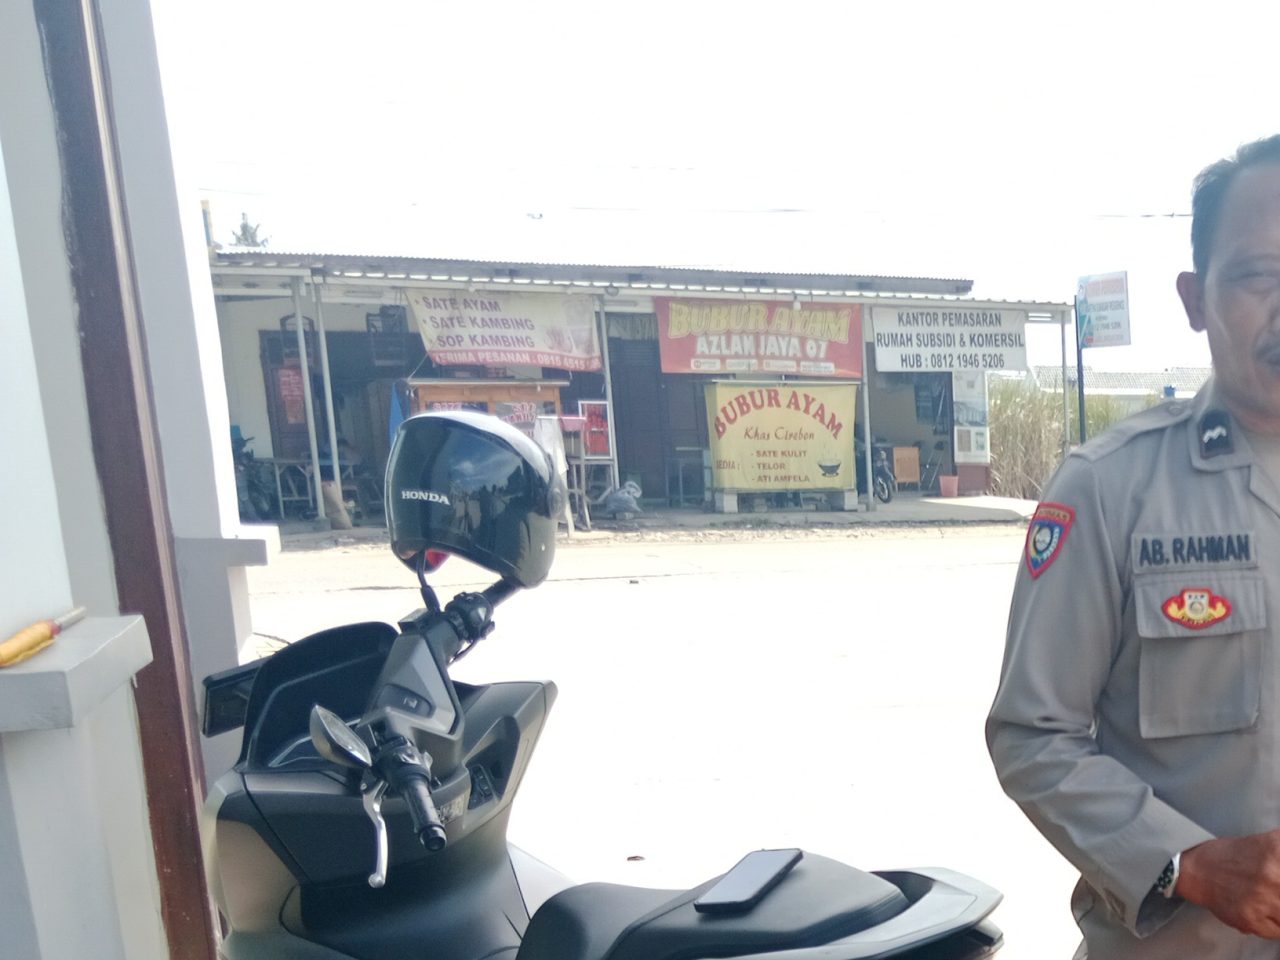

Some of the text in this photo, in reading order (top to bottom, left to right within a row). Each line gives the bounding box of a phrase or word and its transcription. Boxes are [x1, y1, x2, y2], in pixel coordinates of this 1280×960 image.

[422, 296, 501, 313] SATE AYAM
[430, 316, 535, 331] SATE KAMBING
[668, 301, 851, 344] BUBUR AYAM
[897, 311, 1002, 327] KANTOR PEMASARAN
[437, 333, 535, 348] SOP KAMBING
[757, 335, 802, 357] JAYA
[876, 332, 1025, 348] RUMAH SUBSIDI & KOMERSIL
[900, 353, 922, 368] HUB
[930, 353, 954, 368] 0812
[957, 353, 980, 368] 1946
[982, 354, 1005, 368] 5206
[714, 388, 843, 440] BUBUR AYAM
[744, 426, 815, 441] Khas Cirebon
[755, 450, 807, 458] SATE KULIT
[756, 462, 786, 470] TELOR
[756, 475, 772, 483] ATI
[401, 490, 451, 506] HONDA
[1139, 534, 1250, 567] AB. RAHMAN
